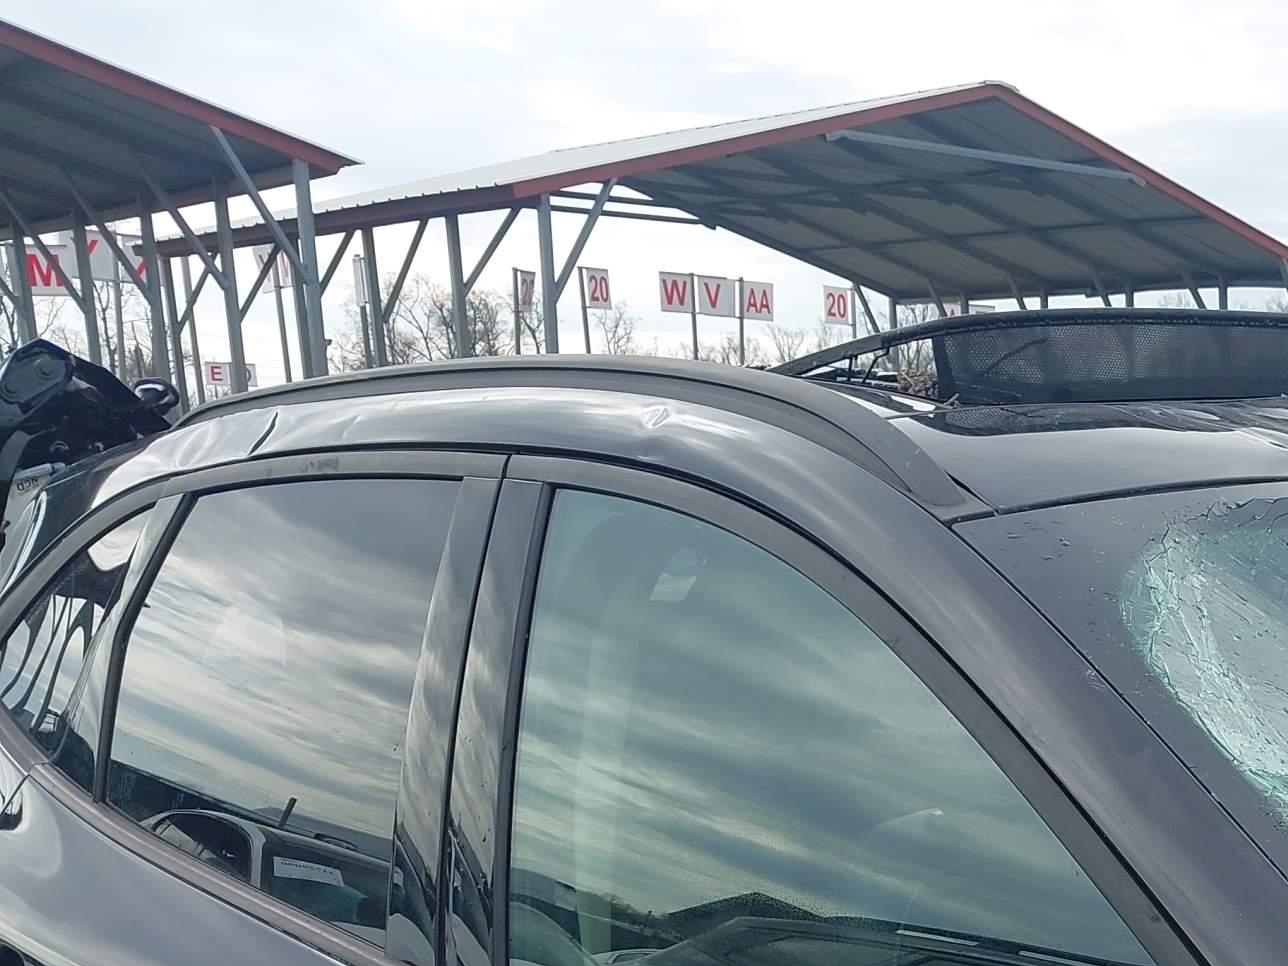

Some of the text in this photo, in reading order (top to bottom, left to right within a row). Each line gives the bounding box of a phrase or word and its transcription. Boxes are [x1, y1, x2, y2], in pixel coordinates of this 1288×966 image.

[26, 253, 65, 287] M
[588, 275, 609, 303] 20
[662, 279, 687, 306] W
[703, 282, 721, 308] V
[747, 288, 771, 313] AA
[826, 292, 847, 318] 20
[210, 366, 223, 381] E
